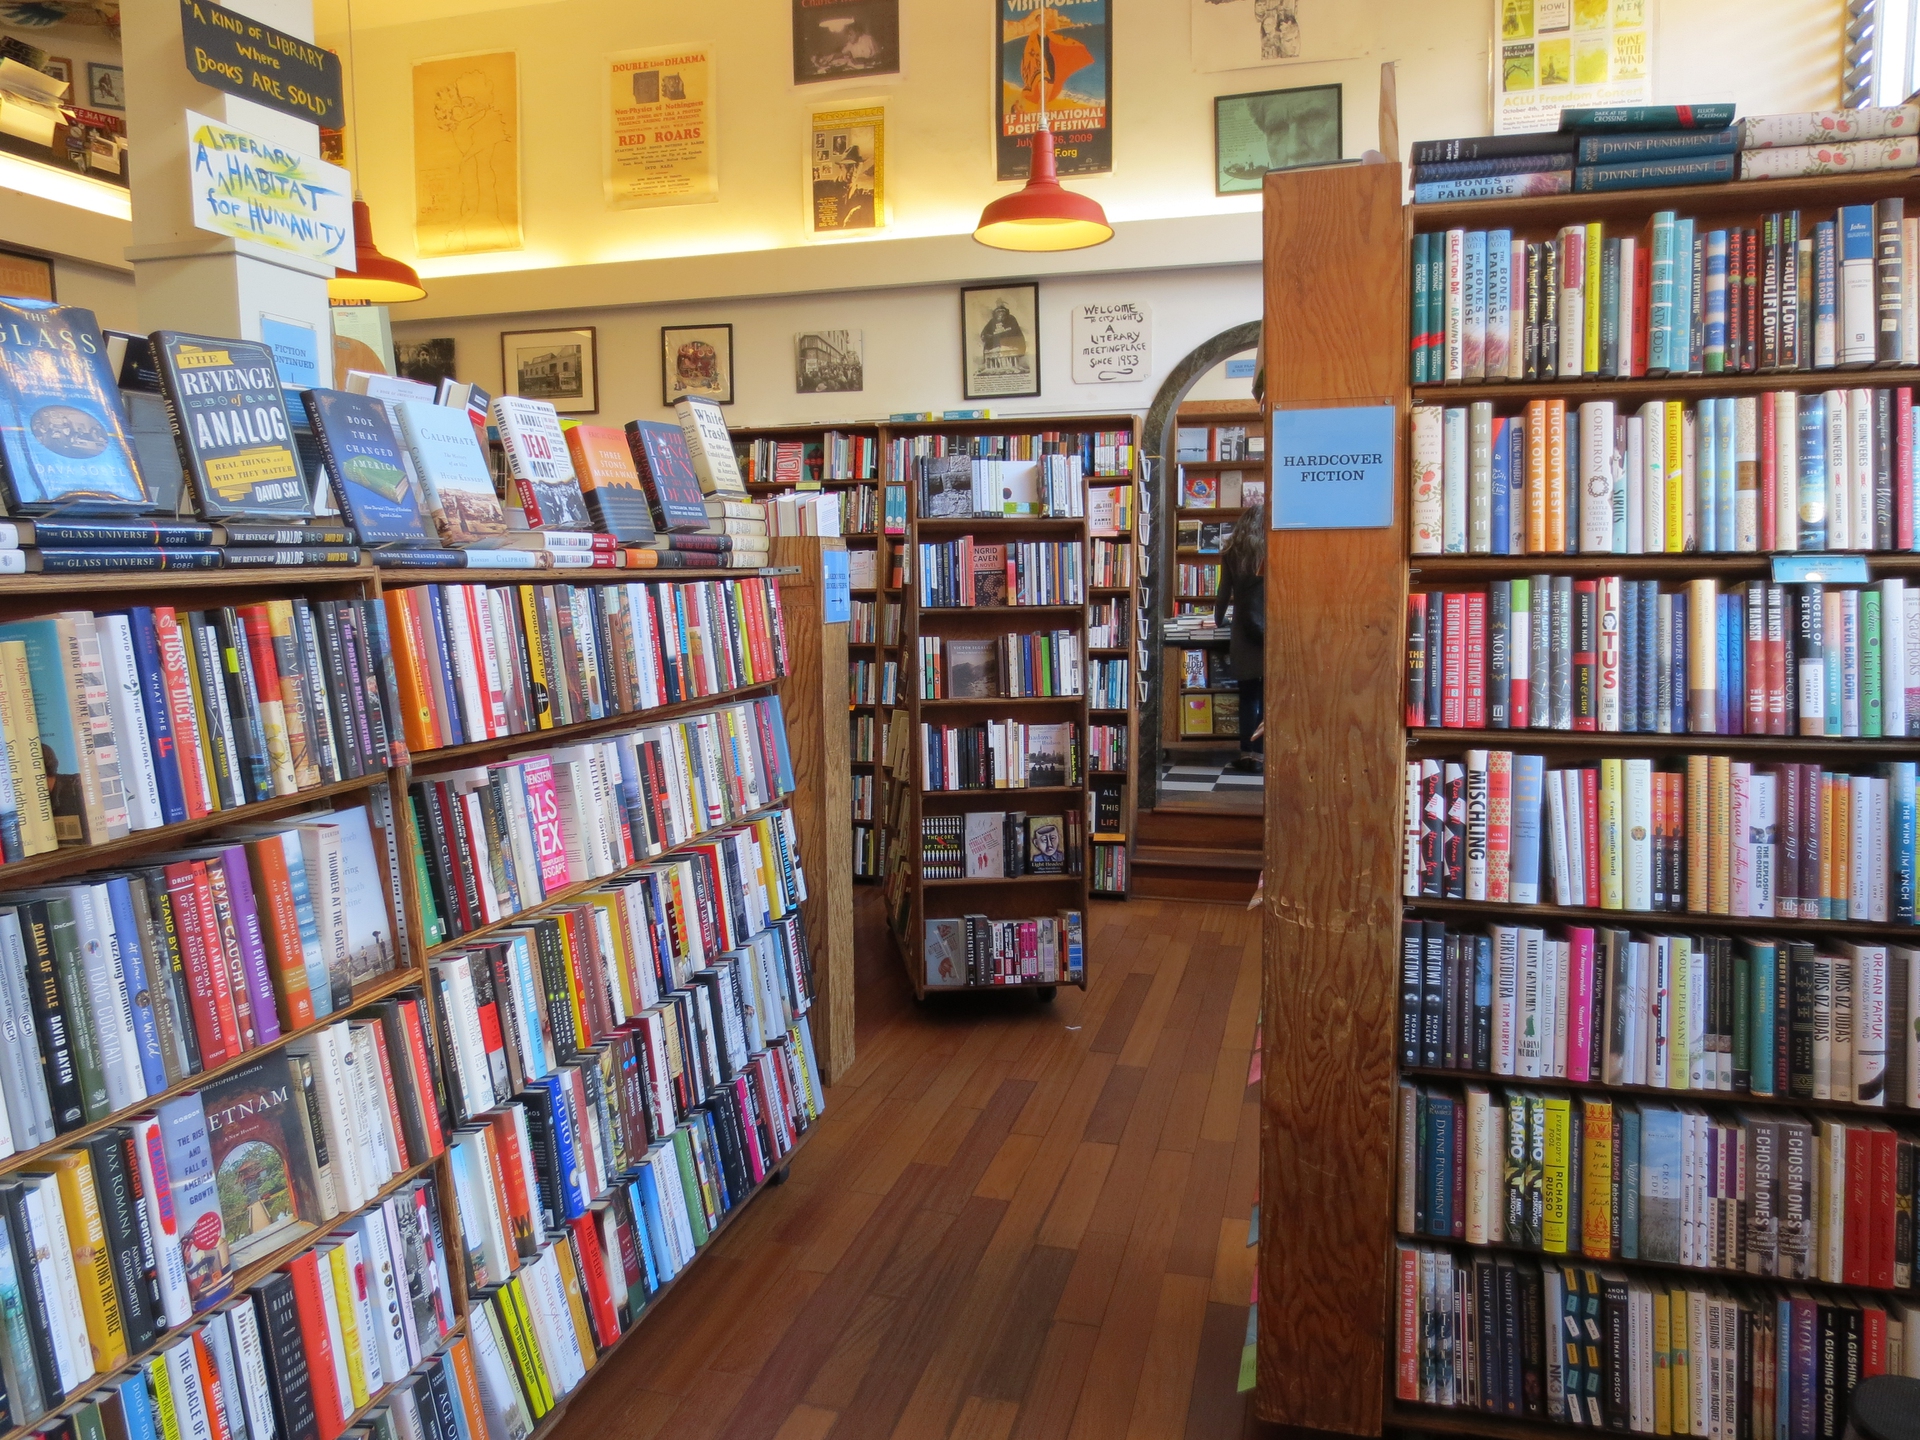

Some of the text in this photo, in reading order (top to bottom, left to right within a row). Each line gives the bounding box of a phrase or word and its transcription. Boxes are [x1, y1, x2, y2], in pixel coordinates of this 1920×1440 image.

[1540, 3, 1566, 11] HOWL
[211, 10, 244, 36] KIND
[248, 24, 262, 40] OF
[266, 32, 323, 71] LIBRARY
[1617, 35, 1641, 44] GONE
[235, 41, 280, 70] Where
[1617, 46, 1640, 55] WITH
[1619, 54, 1644, 64] WIND
[612, 62, 648, 72] DOUBLE
[665, 55, 706, 66] DHARMA
[252, 70, 284, 100] ARE
[665, 101, 704, 110] Nothingness
[1504, 87, 1643, 107] ACLU Freedom Concert
[1005, 114, 1017, 124] SF
[1054, 119, 1101, 131] FESTIVAL
[618, 128, 701, 146] RED ROARS
[1017, 138, 1032, 147] July
[1069, 133, 1093, 143] 2009
[1603, 134, 1713, 154] DIVINE PUNISHMENT
[206, 126, 302, 169] LITERARY
[196, 139, 343, 212] A HABITAT
[1454, 177, 1501, 187] BONES
[1437, 186, 1514, 199] PARADISE
[207, 187, 346, 256] for HUMANITY
[1451, 234, 1459, 295] SELECTION DAY
[1084, 303, 1138, 315] WELCOME
[1762, 262, 1777, 350] CAULIFLOWER
[1117, 312, 1143, 323] LIGHTS
[1091, 332, 1140, 344] LITERARY
[1105, 325, 1115, 333] A
[184, 354, 219, 365] THE
[275, 344, 306, 357] FICTION
[274, 355, 314, 369] ONTINUED
[1090, 355, 1139, 368] SINCE 1953
[180, 368, 274, 396] REVENGE
[231, 394, 242, 407] of
[195, 405, 288, 449] ANALOG
[347, 416, 374, 427] BOOK
[694, 409, 724, 425] White
[352, 431, 378, 441] THAT
[421, 428, 476, 446] CALIPHATE
[1593, 408, 1603, 473] CORTHRON
[346, 444, 393, 457] CHANGED
[521, 434, 552, 459] DEAD
[599, 451, 621, 460] THREE
[215, 460, 238, 470] REAL
[241, 458, 271, 468] THINGS
[353, 460, 397, 471] AMERICA
[529, 460, 558, 478] MONEY
[601, 461, 627, 470] STONES
[1284, 453, 1383, 466] HARDCOVER
[1531, 408, 1542, 514] HUCK OUT WEST
[214, 466, 293, 482] WHY THEY MATTER
[594, 469, 613, 477] MAKE
[620, 471, 638, 479] WALL
[1300, 469, 1365, 483] FICTION
[255, 481, 302, 502] DAVID SAX
[1614, 489, 1624, 523] SIRIUS
[972, 554, 998, 562] CAVEN
[974, 547, 998, 555] NGRID
[67, 557, 155, 568] GLASS UNIVERSE
[1749, 588, 1762, 641] RON HANSEN
[1801, 596, 1810, 639] DETROIT
[1812, 588, 1821, 647] ANGELS OF
[121, 624, 130, 653] DAVID
[163, 631, 183, 672] TOSS
[1492, 634, 1504, 670] MORE
[1410, 660, 1424, 669] YID
[151, 673, 167, 731] WHAT THE
[1102, 789, 1119, 797] ALL
[1100, 803, 1119, 812] THIS
[1469, 770, 1486, 861] MISCHLING
[1101, 819, 1118, 827] LIFE
[327, 850, 346, 959] THUNDER GATES
[160, 895, 182, 972] STAND BY ME
[212, 868, 245, 992] NEVER CAUGHT
[246, 913, 270, 999] HUMAN EVOLUTION
[1404, 938, 1419, 985] DARKTOWN
[1499, 933, 1515, 1058] CHRISTODORA TIM MURPHY
[1815, 962, 1830, 1041] AMOS OZ JUDAS
[1872, 953, 1884, 1040] ORHAN PAMUK
[50, 1015, 73, 1084] DAVID DAYEN
[207, 1087, 291, 1133] ETNAM
[555, 1093, 572, 1146] EURO
[1510, 1107, 1524, 1159] IDAHO
[106, 1143, 133, 1239] PAX ROMANA
[1755, 1137, 1771, 1226] CHOSEN ONES
[1546, 1177, 1554, 1211] RUSSO
[1555, 1171, 1563, 1219] RICHARD
[136, 1199, 156, 1268] Nuremberg
[585, 1224, 605, 1280] FREE SPEECH
[1800, 1309, 1813, 1366] SMOKE
[1824, 1339, 1835, 1437] GUSHING FOUNTAIN
